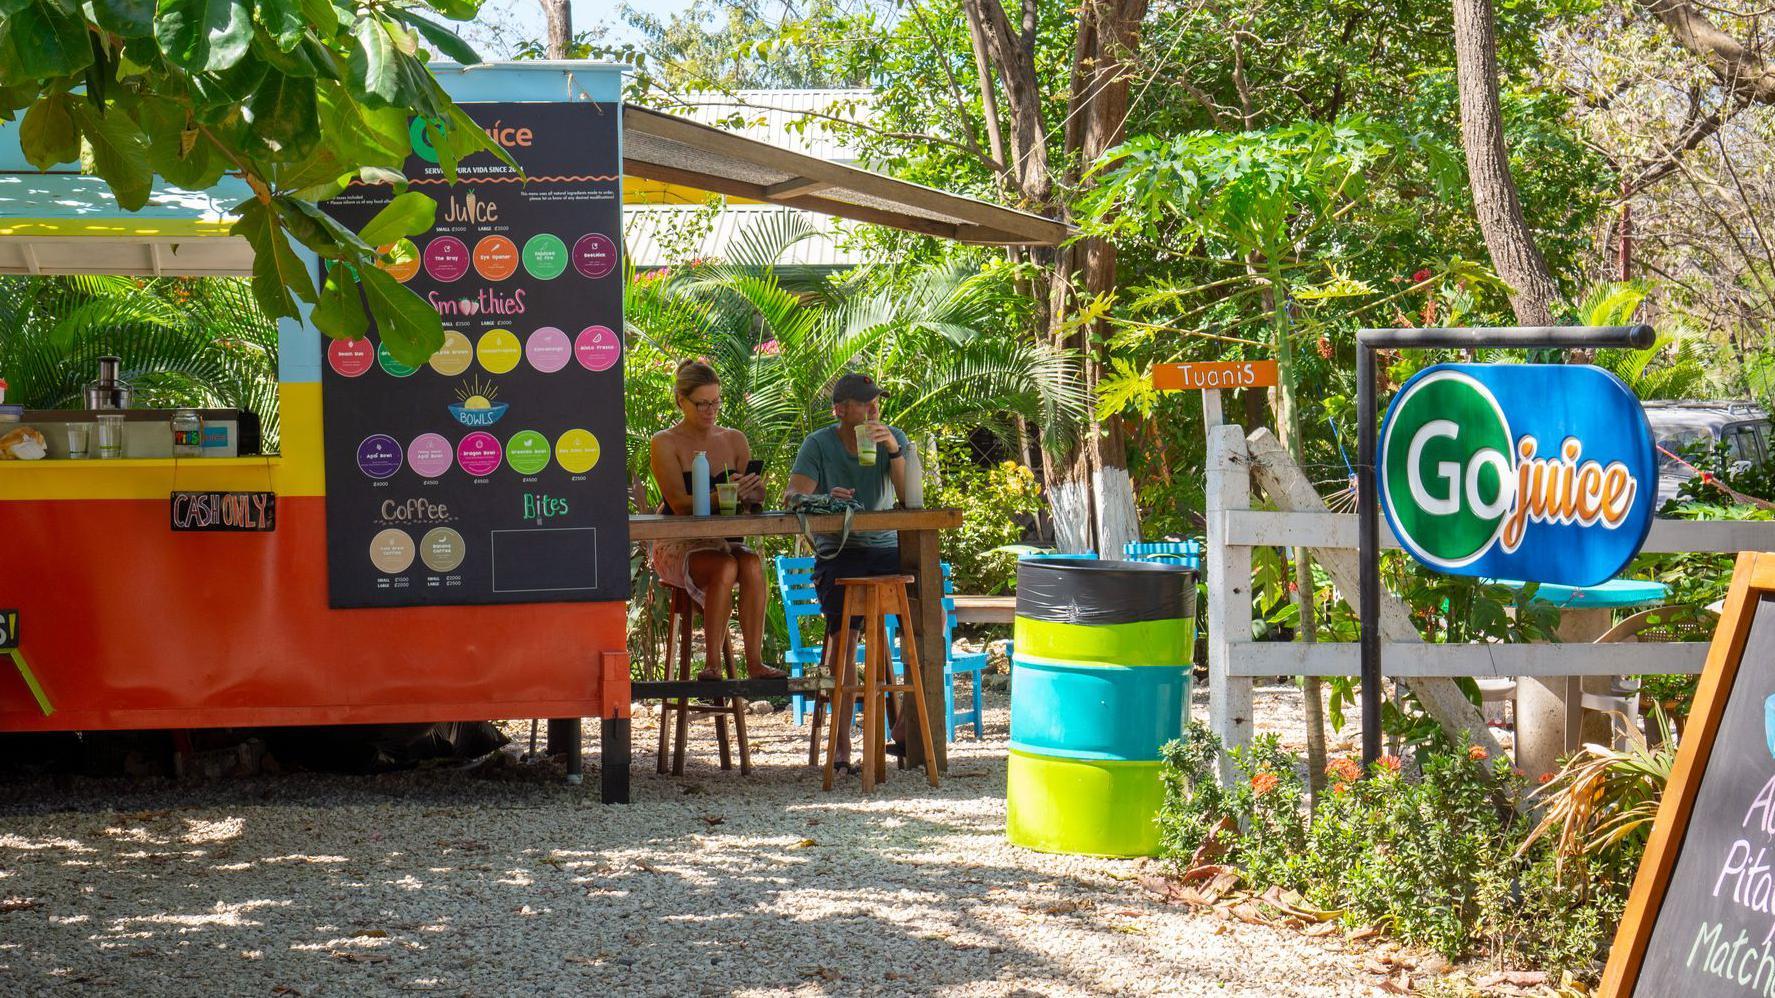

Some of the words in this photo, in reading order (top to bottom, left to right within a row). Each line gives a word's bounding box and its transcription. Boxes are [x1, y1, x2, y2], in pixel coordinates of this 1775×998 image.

[445, 190, 498, 224] Juice
[460, 412, 494, 425] BOWLS
[174, 494, 220, 528] CASH
[222, 493, 268, 529] ONLY
[381, 497, 449, 520] Coffee
[523, 493, 569, 522] Bites
[1712, 839, 1775, 945] Pita
[1686, 921, 1775, 998] Match
